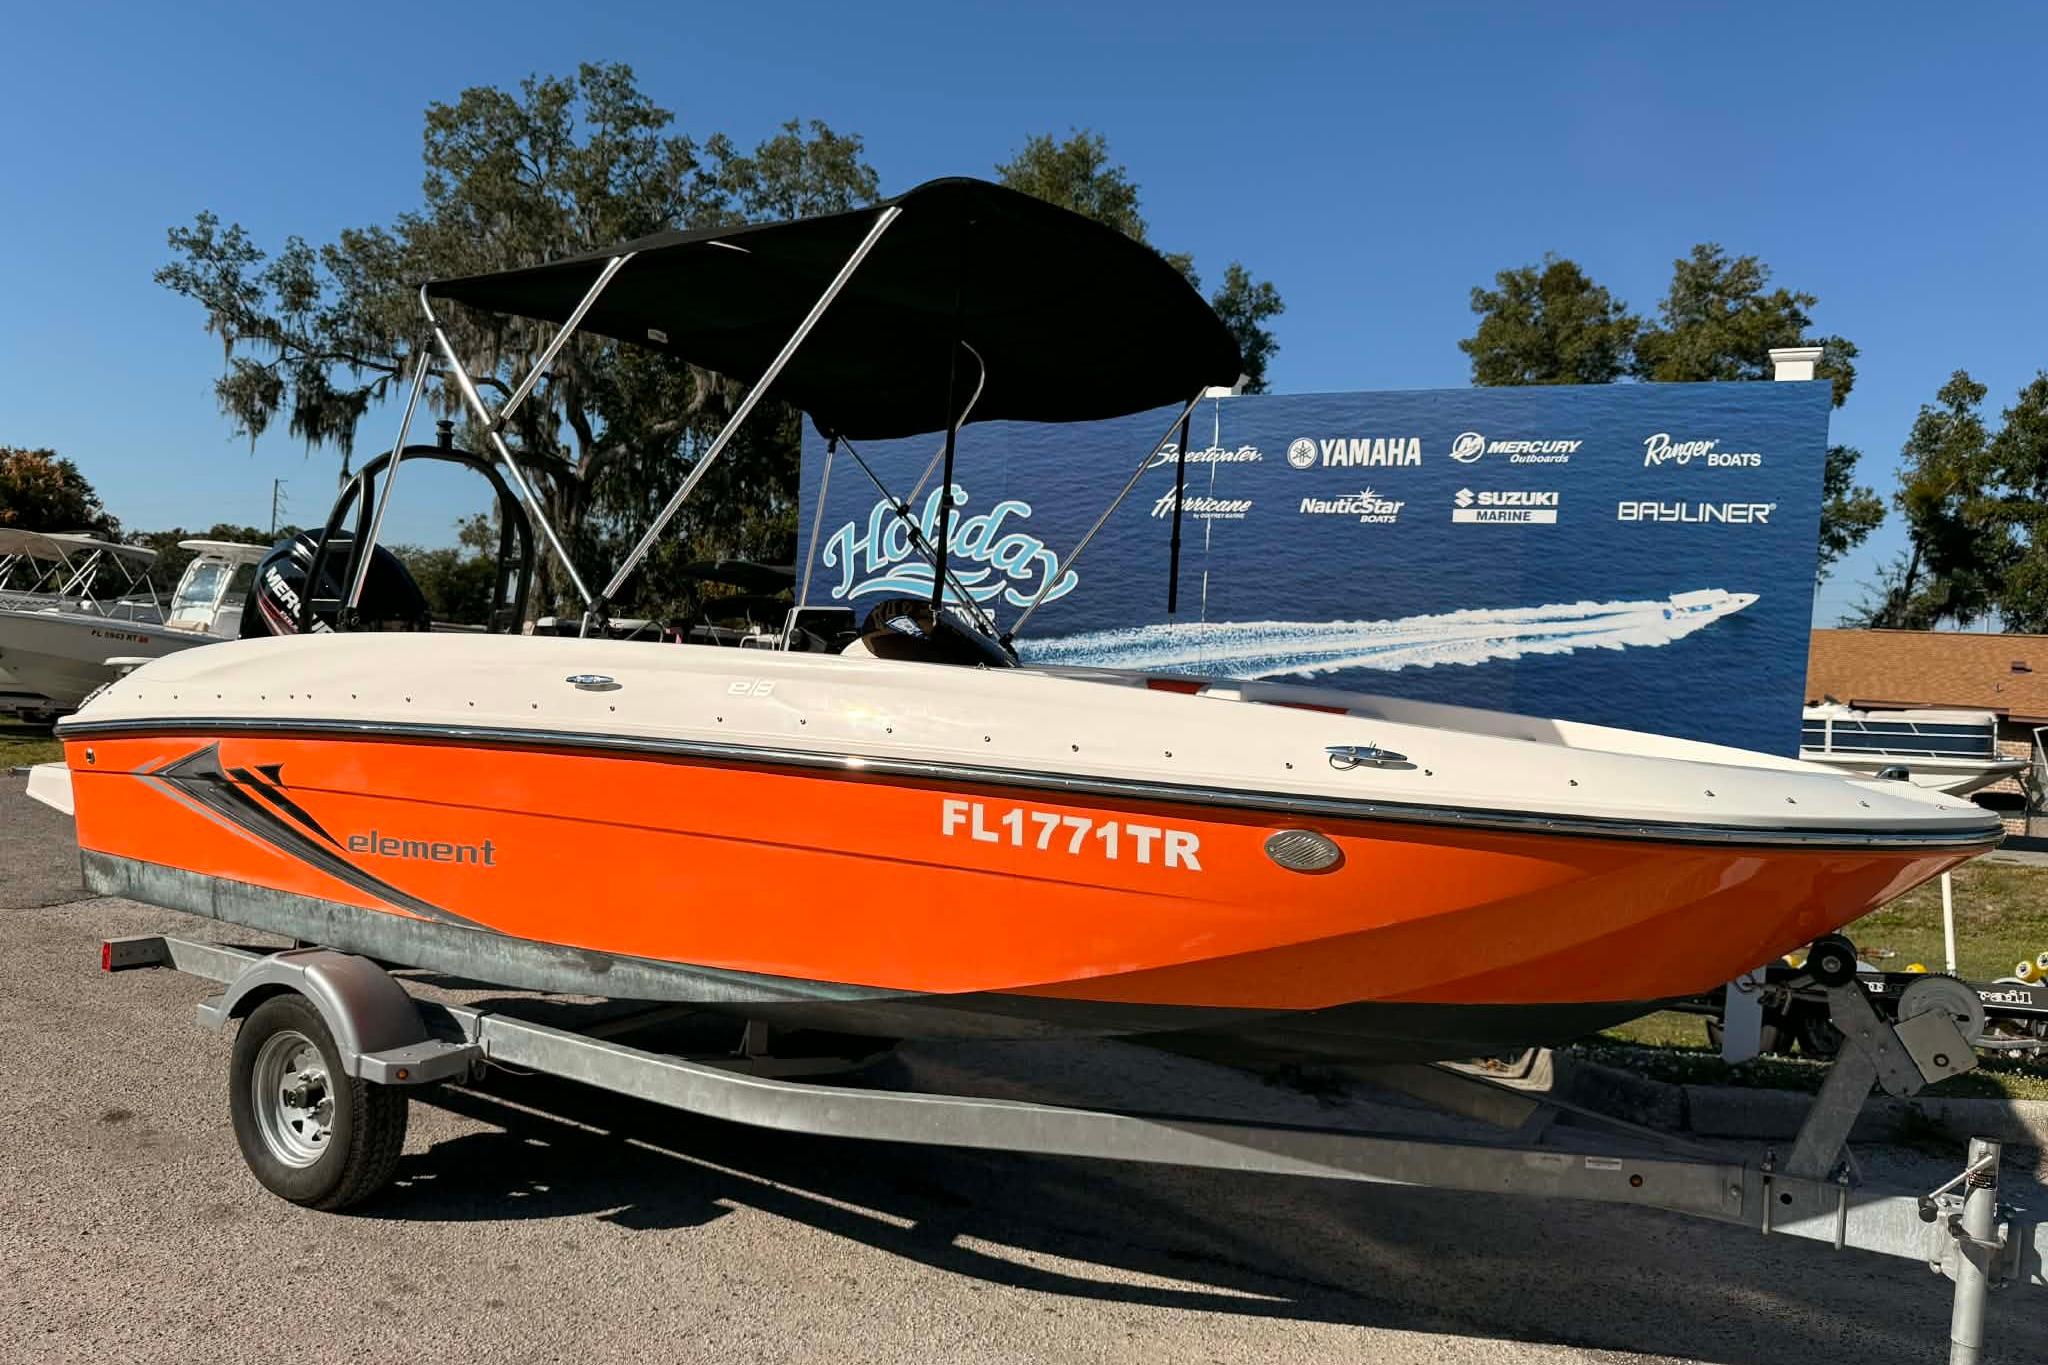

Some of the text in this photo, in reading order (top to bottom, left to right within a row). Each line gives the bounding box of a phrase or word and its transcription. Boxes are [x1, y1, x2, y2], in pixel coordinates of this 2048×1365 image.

[1319, 437, 1421, 467] YAMAHA
[1487, 440, 1582, 454] MERCURY
[1643, 432, 1762, 468] Ranger BOATS
[1510, 453, 1569, 463] Outboards
[1300, 497, 1404, 514] NauticStar
[1477, 491, 1559, 506] SUZUKI
[1360, 515, 1398, 523] BOATS
[1476, 510, 1532, 522] MARINE
[823, 483, 1079, 608] Holiday
[942, 798, 1202, 872] FL1771TR
[348, 829, 497, 867] element
